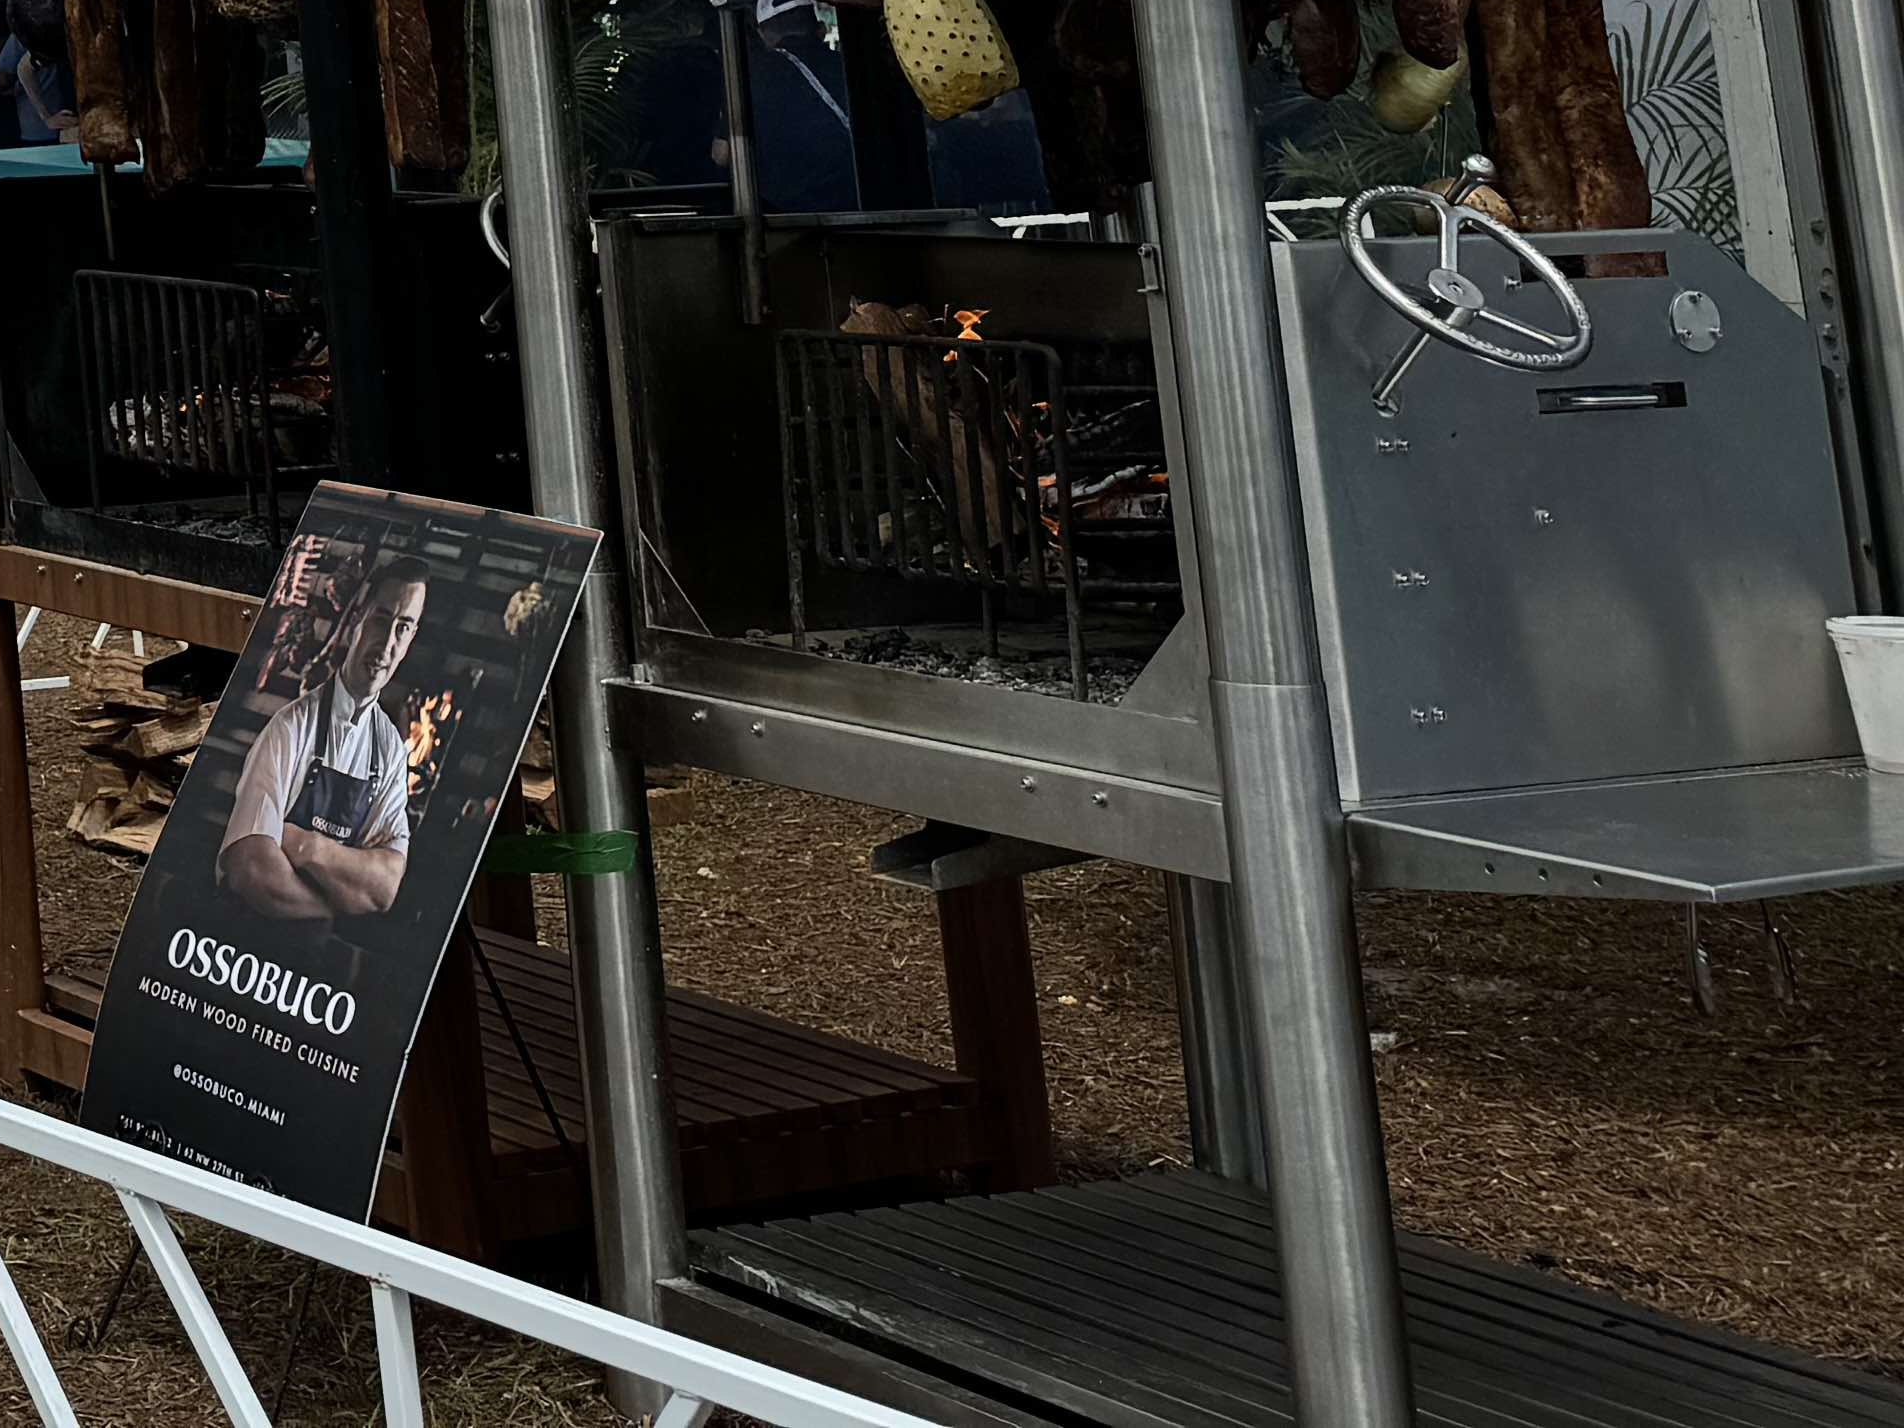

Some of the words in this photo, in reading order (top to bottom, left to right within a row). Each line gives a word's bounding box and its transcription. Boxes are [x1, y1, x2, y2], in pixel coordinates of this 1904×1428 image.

[138, 976, 198, 1014] MODERN
[201, 1001, 247, 1034] WOOD
[251, 1023, 292, 1054] FIRED
[297, 1044, 360, 1084] CUISINE
[167, 928, 356, 1035] OSSOBUCO
[173, 1064, 286, 1126] @OSSOBUCO.MIAMI
